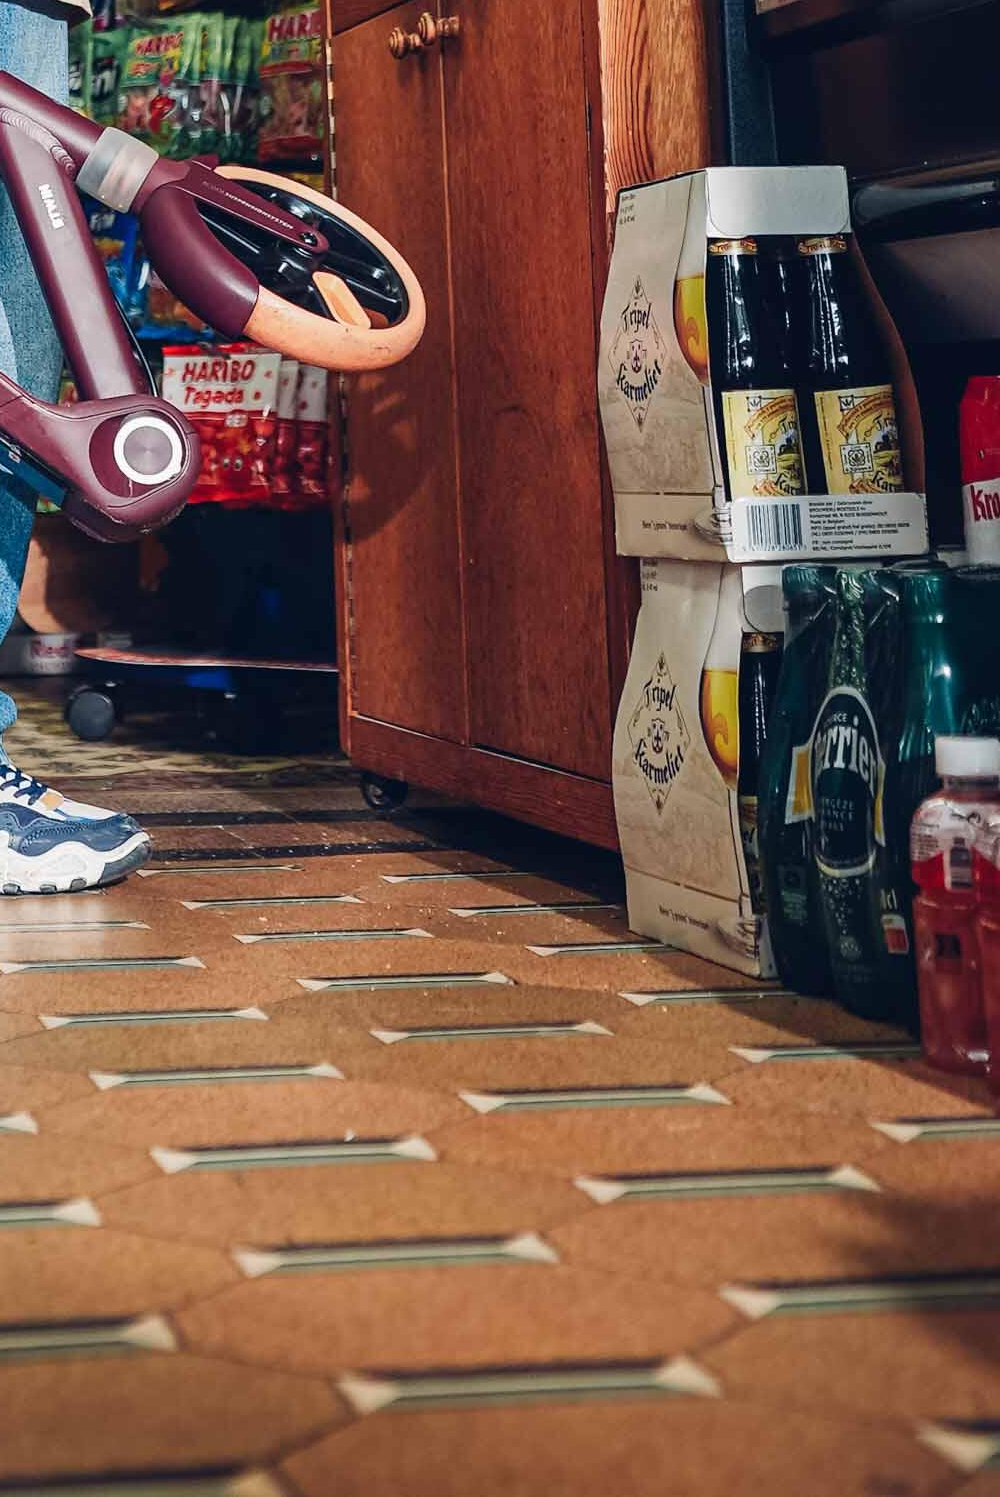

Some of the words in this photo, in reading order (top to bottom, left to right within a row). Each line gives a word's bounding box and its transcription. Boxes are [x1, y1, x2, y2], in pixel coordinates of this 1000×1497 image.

[38, 183, 65, 229] BTWIN
[621, 301, 652, 334] Tripel
[182, 359, 255, 384] HARIBO
[184, 386, 245, 408] Tagada
[643, 677, 677, 712] Tripel
